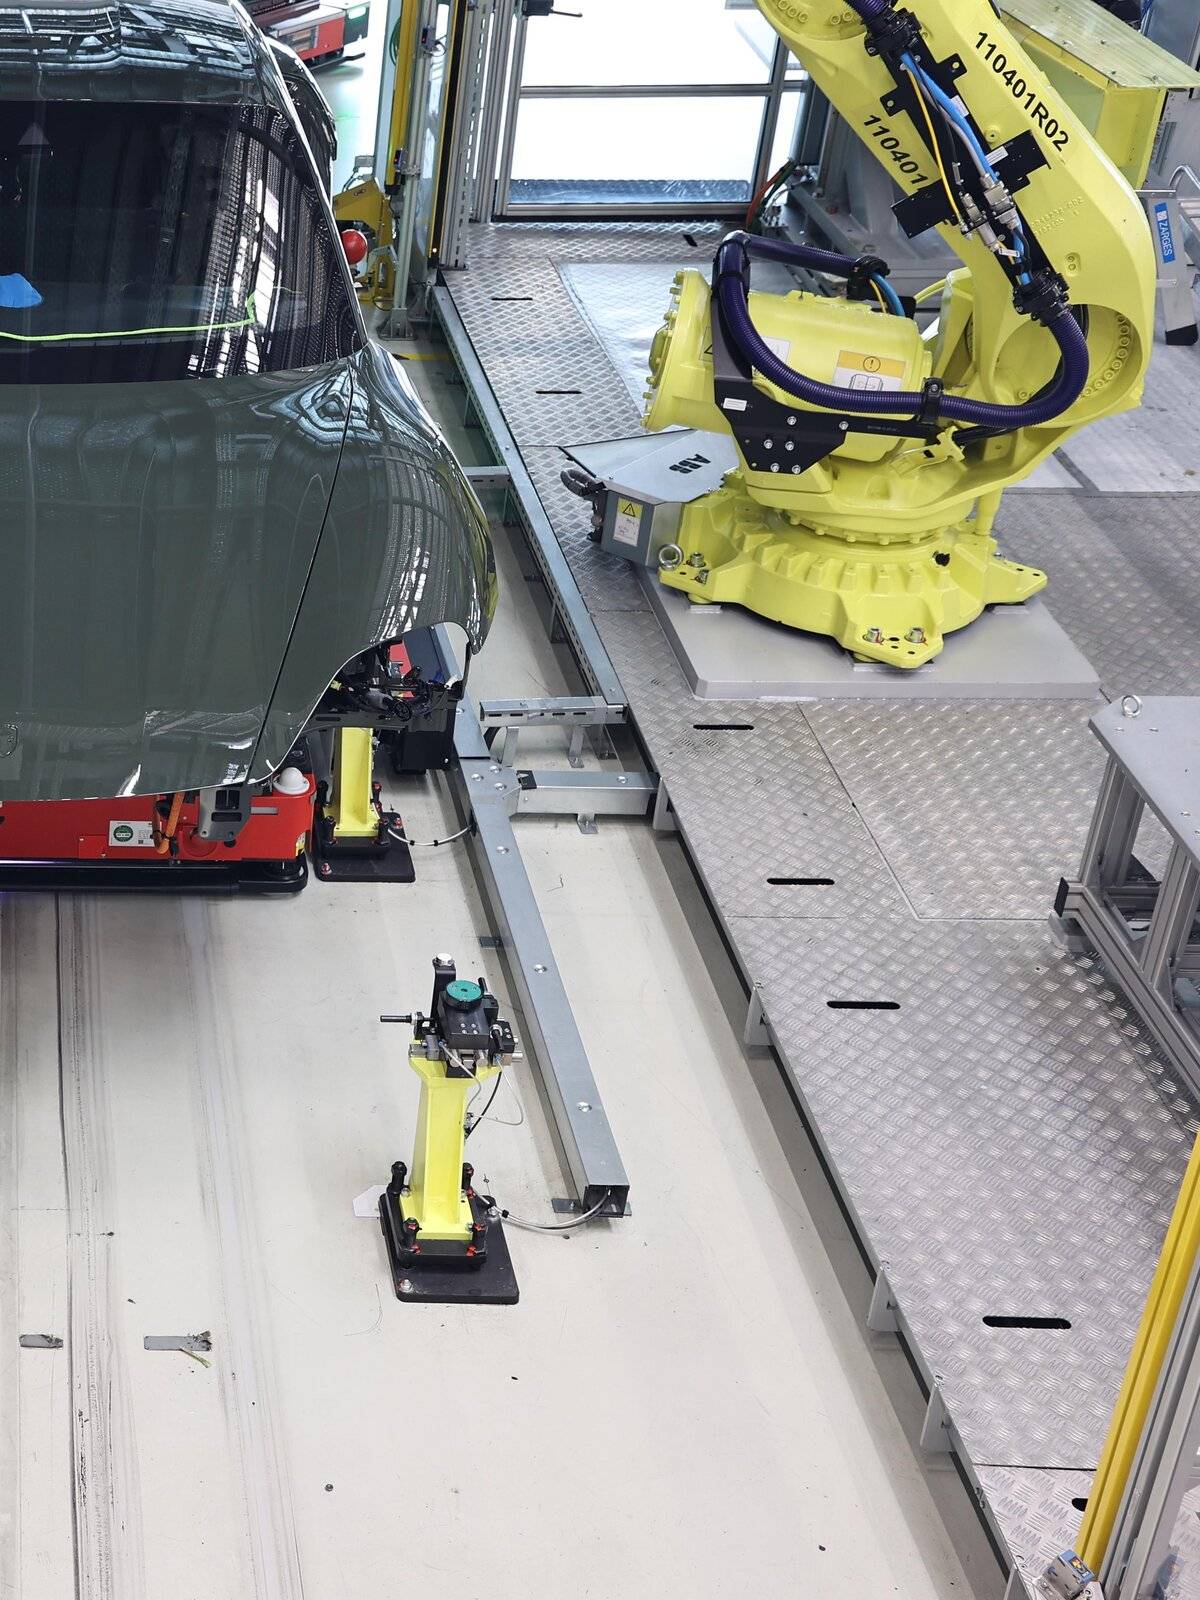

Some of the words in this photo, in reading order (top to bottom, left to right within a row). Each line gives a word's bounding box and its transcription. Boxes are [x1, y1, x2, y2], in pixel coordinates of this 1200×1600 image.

[974, 31, 1069, 152] 110401R02
[863, 114, 929, 185] 110401
[1159, 220, 1173, 256] ZARGES
[668, 453, 711, 474] ABB
